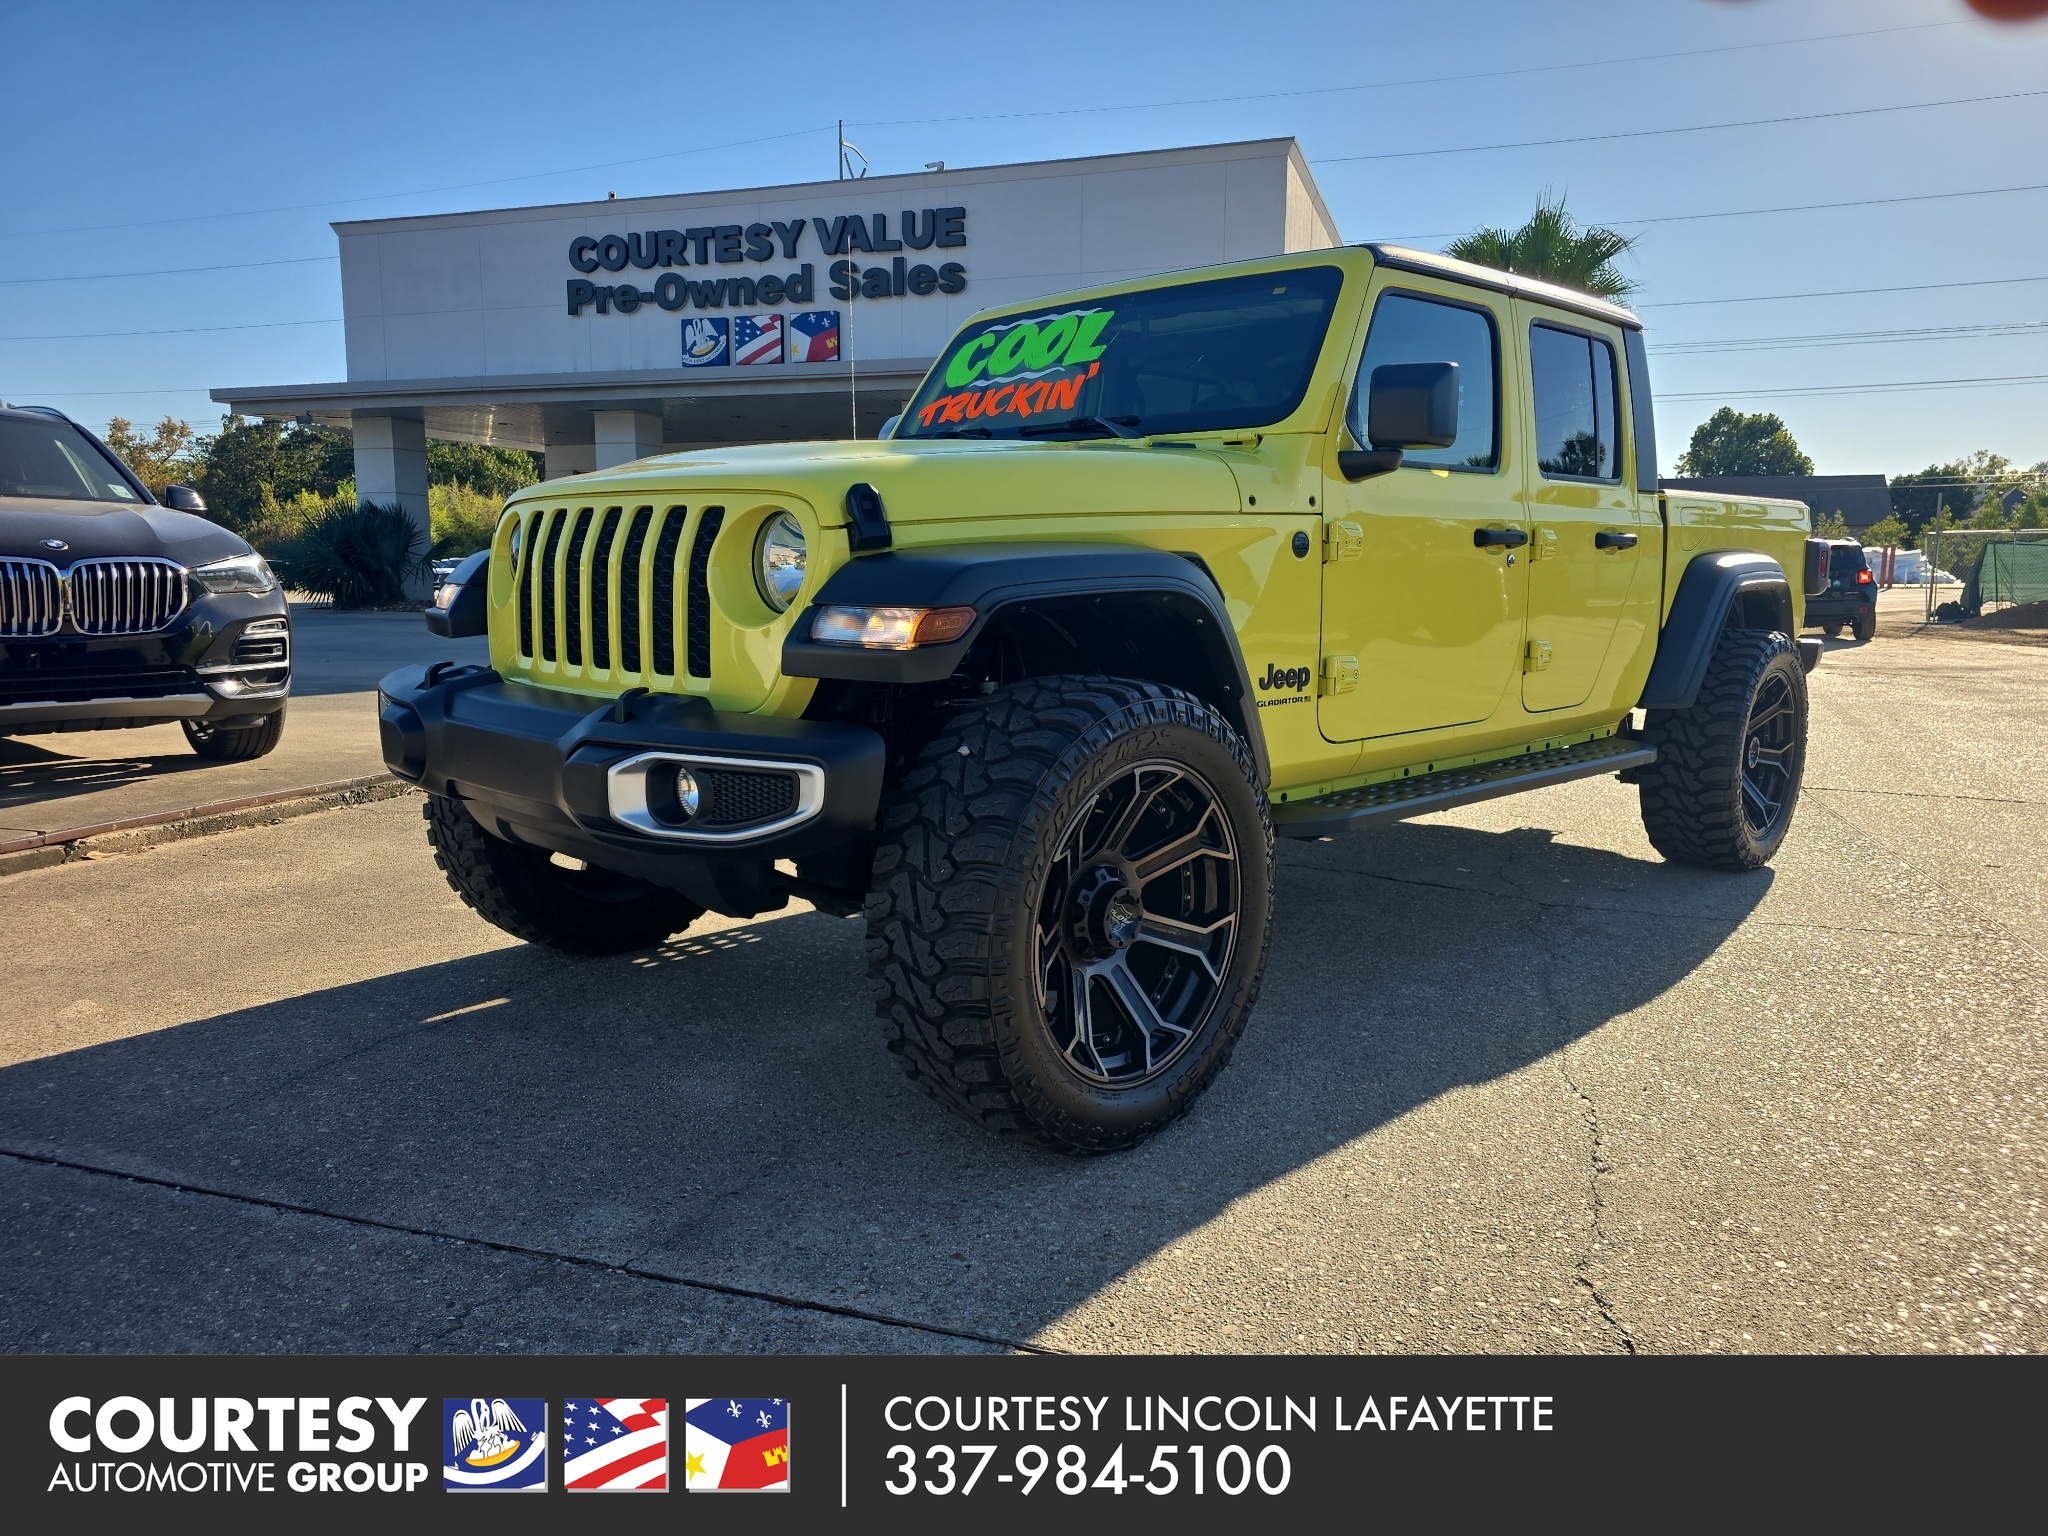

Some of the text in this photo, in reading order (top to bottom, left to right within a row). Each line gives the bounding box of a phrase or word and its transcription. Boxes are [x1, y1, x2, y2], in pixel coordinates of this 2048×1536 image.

[568, 206, 967, 274] COURTESY VALUE
[566, 256, 968, 317] Pre-Owned Sales
[945, 311, 1114, 388] COOL
[918, 362, 1099, 427] TRUCKIN'
[1256, 696, 1304, 708] GLADIATOR
[1258, 662, 1311, 693] Jeep
